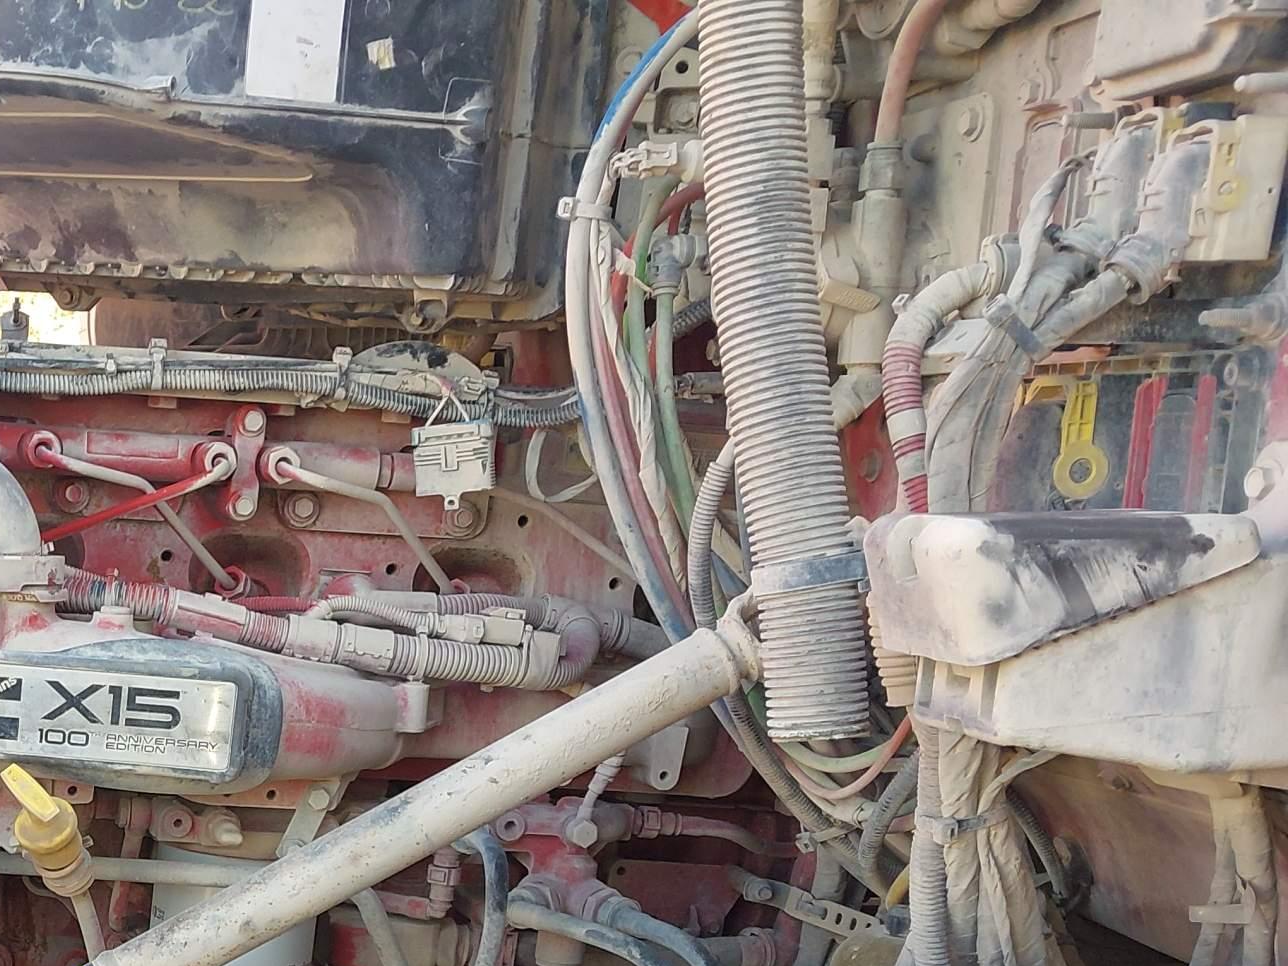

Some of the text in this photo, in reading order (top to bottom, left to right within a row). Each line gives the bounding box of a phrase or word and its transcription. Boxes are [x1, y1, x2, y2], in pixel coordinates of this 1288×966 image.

[41, 680, 182, 730] X15
[105, 733, 218, 751] ANNIVERSARY
[105, 742, 166, 754] EDITION
